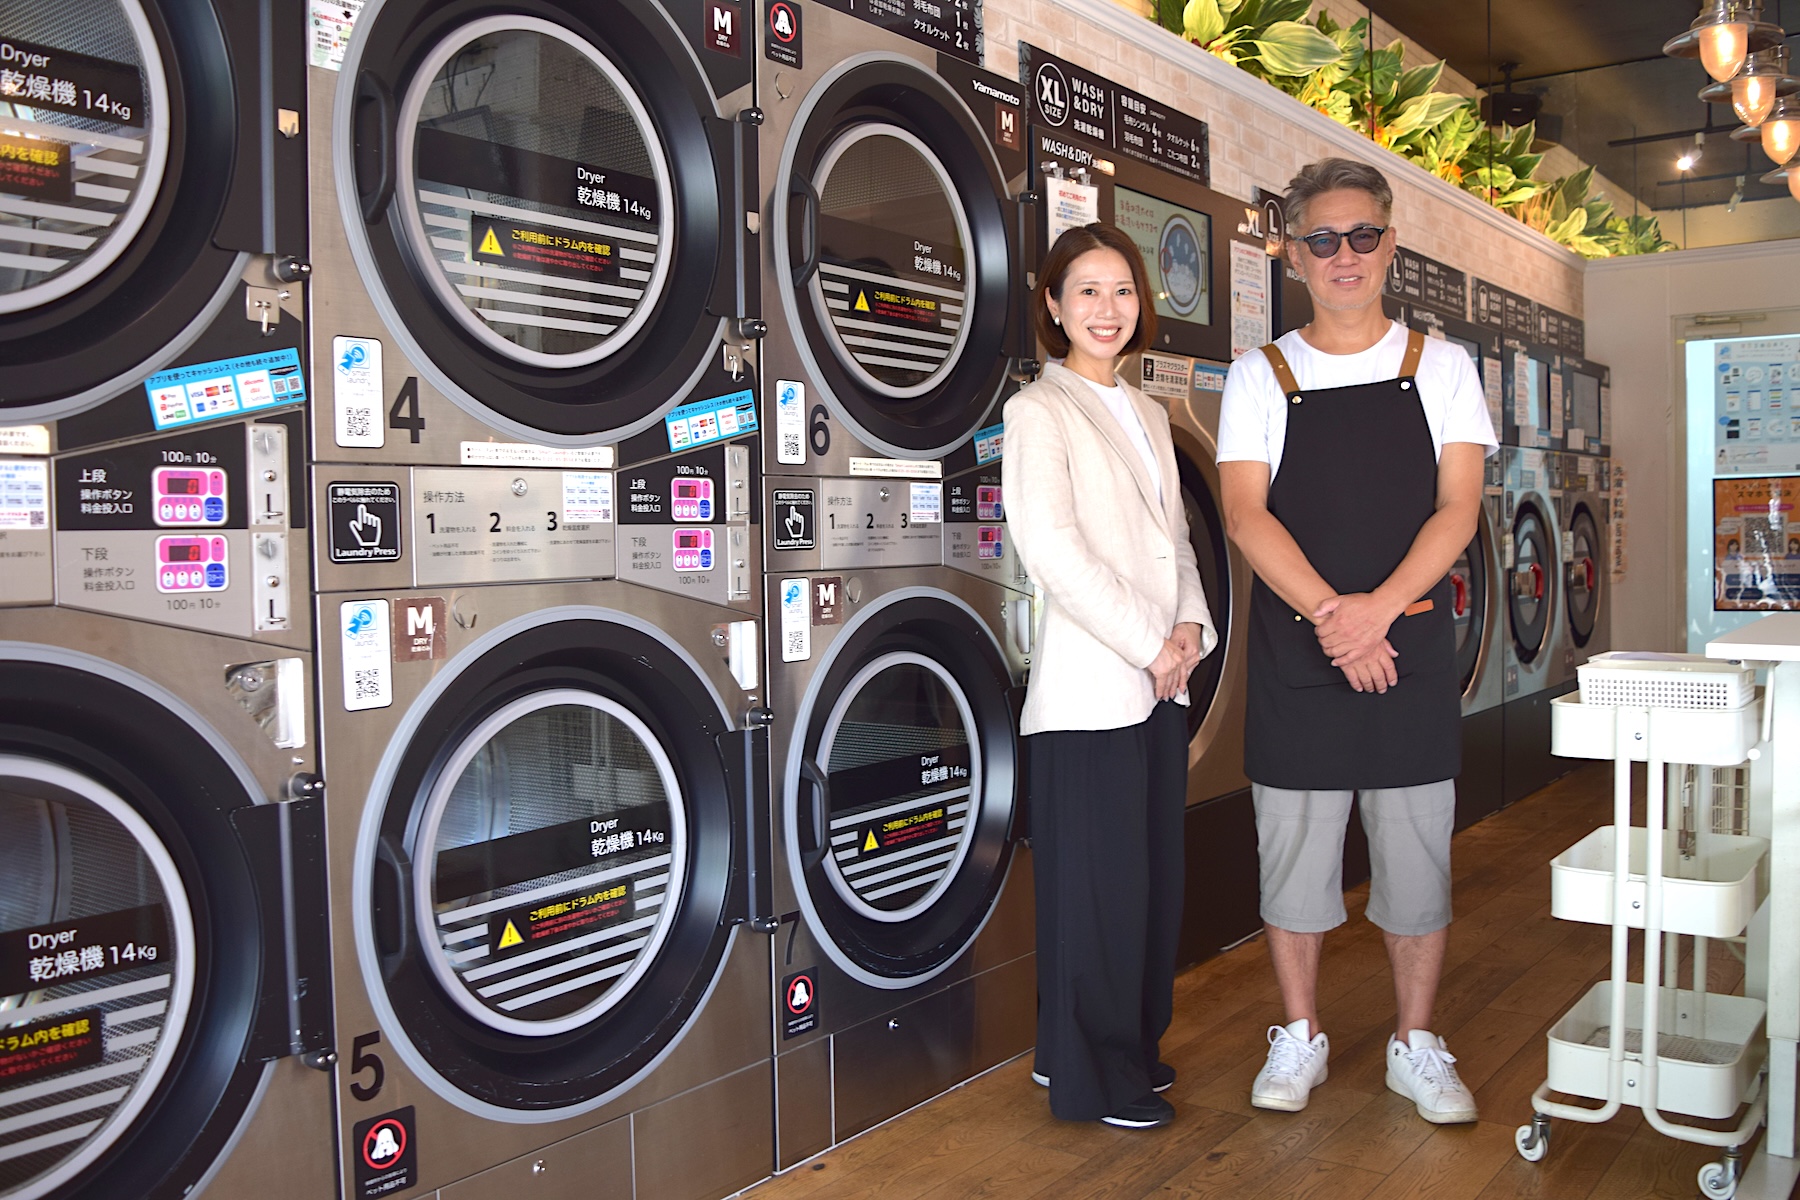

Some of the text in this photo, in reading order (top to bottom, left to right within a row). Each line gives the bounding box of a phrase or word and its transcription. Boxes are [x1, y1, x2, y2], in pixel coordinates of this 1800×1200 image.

[912, 0, 942, 19] 羽毛布団
[713, 6, 732, 36] M
[913, 19, 951, 42] タオルケット
[717, 33, 729, 41] DRY
[1, 43, 50, 69] Dryer
[0, 68, 132, 120] 乾燥機 14Kg
[972, 79, 1020, 106] Yamamoto
[1040, 75, 1066, 109] XL
[1071, 76, 1105, 104] WASH
[1044, 103, 1063, 119] SIZE
[1073, 95, 1105, 120] &DRY
[1120, 94, 1147, 116] 容量目安
[1001, 110, 1014, 133] M
[1072, 118, 1106, 141] 洗濯乾燥機
[1042, 136, 1093, 166] WASH&DRY
[577, 166, 606, 184] Dryer
[577, 186, 652, 220] 乾燥機 14Kg
[1268, 208, 1278, 234] L
[511, 228, 612, 257] ご利用前にドラム内を確認
[914, 240, 933, 254] Dryer
[914, 255, 961, 281] 乾燥機 14Kg
[874, 290, 936, 311] ご利用前にドラム内を確認
[150, 363, 231, 385] アプリを使ってキャッシュレス
[389, 376, 425, 444] 4
[810, 404, 831, 457] 6
[162, 450, 192, 463] 100円
[78, 469, 107, 484] 上段
[676, 465, 694, 475] 100円
[80, 489, 133, 501] 操作ボタン
[337, 487, 392, 497] 静電気除去のため
[629, 479, 646, 491] 上段
[950, 486, 962, 496] 上段
[423, 490, 465, 503] 操作方法
[630, 493, 661, 504] 操作ボタン
[81, 503, 133, 515] 料金投入口
[630, 504, 661, 513] 料金投入口
[426, 512, 435, 534] 1
[489, 511, 502, 533] 2
[546, 511, 558, 532] 3
[829, 512, 835, 530] 1
[866, 512, 874, 529] 2
[901, 512, 908, 529] 3
[335, 546, 397, 558] Laundry Press
[631, 536, 647, 548] 下段
[777, 538, 813, 547] Laundry Press
[81, 547, 109, 562] 下段
[632, 552, 661, 561] 操作ボタン
[83, 567, 135, 579] 操作ボタン
[84, 581, 135, 592] 料金投入口
[819, 584, 836, 607] M
[407, 605, 433, 636] M
[413, 638, 430, 646] DRY
[921, 755, 940, 766] Dryer
[921, 765, 968, 785] 乾燥機 14Kg
[590, 817, 619, 834] Dryer
[591, 828, 665, 858] 乾燥機 14Kg
[529, 884, 628, 921] ご利用前にドラム内を確認
[28, 929, 78, 950] Dryer
[780, 910, 801, 966] 7
[29, 942, 158, 983] 乾燥機 14Kg
[350, 1030, 385, 1102] 5
